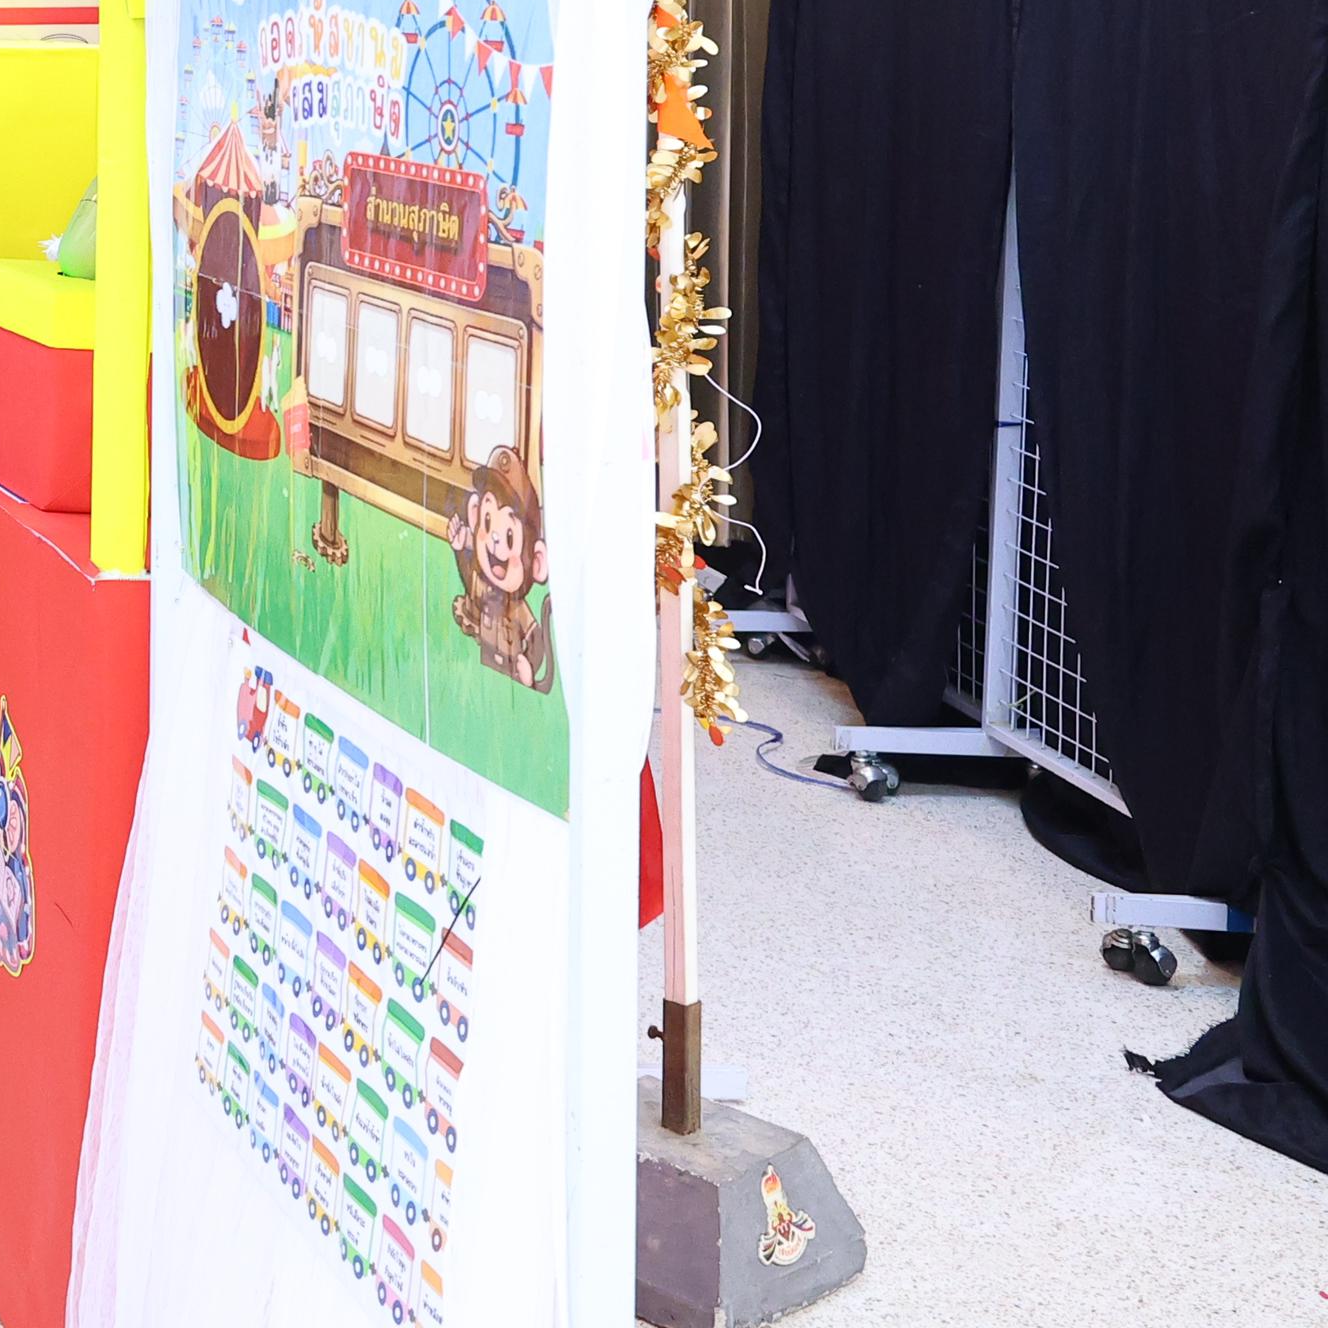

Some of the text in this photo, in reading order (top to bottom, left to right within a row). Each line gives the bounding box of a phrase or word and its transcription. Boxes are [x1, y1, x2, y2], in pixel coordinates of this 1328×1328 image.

[366, 186, 459, 242] สำนวนสุภาษิต
